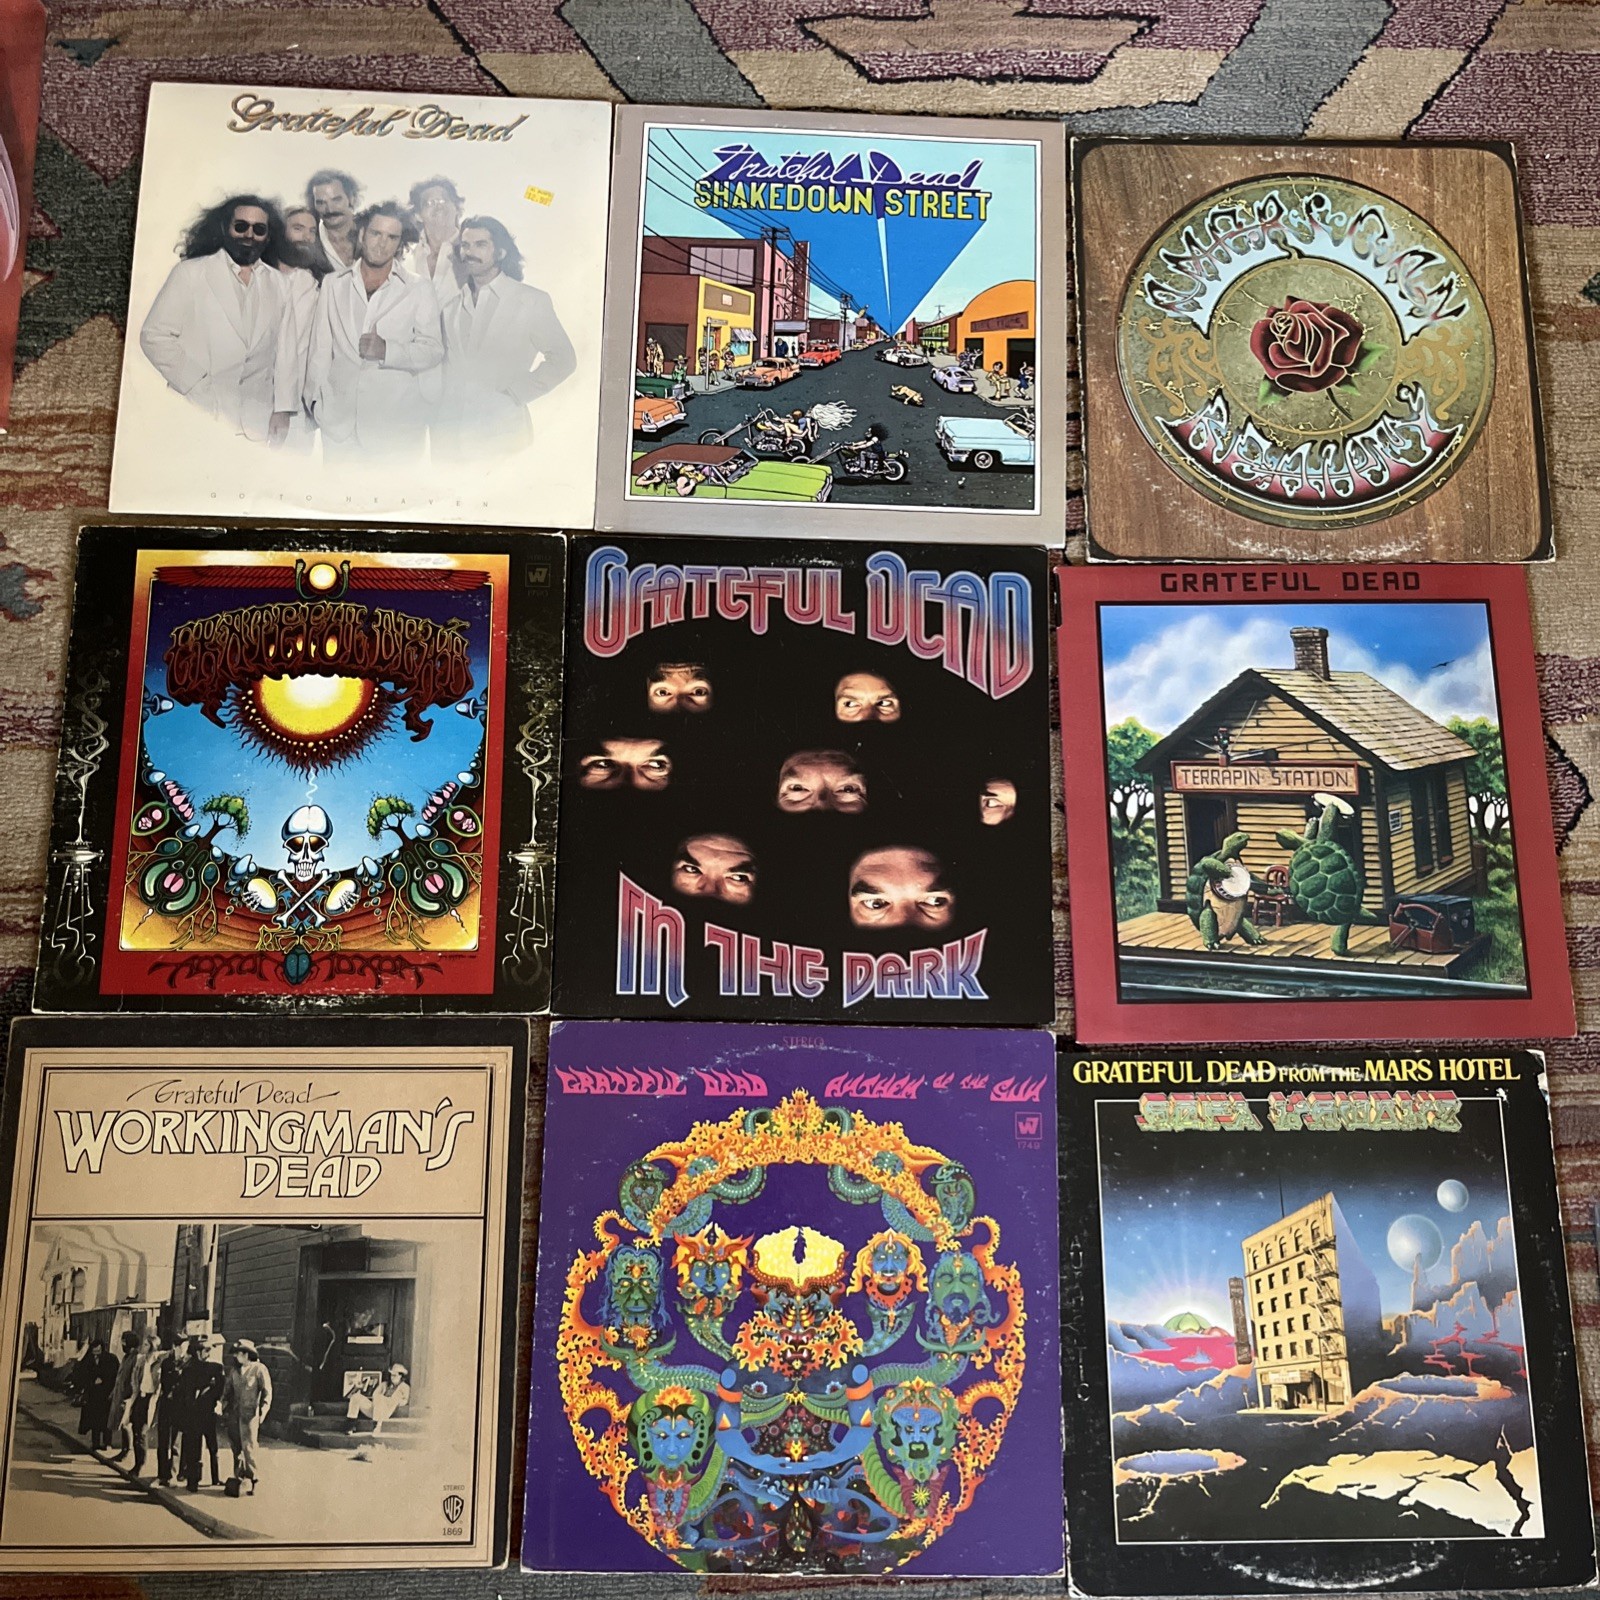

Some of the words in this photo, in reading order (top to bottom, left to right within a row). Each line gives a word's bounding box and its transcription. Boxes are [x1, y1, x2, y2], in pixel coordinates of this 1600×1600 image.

[226, 93, 405, 138] Grateful
[402, 104, 529, 142] Dead
[705, 143, 857, 185] Grateful
[851, 149, 984, 190] Dead
[694, 181, 873, 215] SHAKEDOWN
[885, 189, 992, 221] STREET
[210, 492, 245, 500] GO
[279, 494, 312, 502] TO
[346, 496, 488, 508] HEAVEN
[1160, 571, 1321, 593] GRATEFUL
[1342, 571, 1421, 592] DEAD
[583, 545, 856, 658] GRATEFUL
[865, 550, 1034, 700] DEAD
[1182, 769, 1260, 789] TERRAPIN
[1271, 769, 1349, 789] STATION
[704, 922, 829, 998] THE
[843, 928, 989, 1008] DARK
[783, 1036, 825, 1048] STEREO
[555, 1065, 687, 1096] GRATEFUL
[694, 1067, 768, 1097] DEAD
[824, 1071, 925, 1099] ANTHEM
[932, 1072, 955, 1089] OF
[960, 1073, 990, 1089] THE
[990, 1074, 1048, 1102] SUN
[1072, 1060, 1201, 1084] GRATEFUL
[1206, 1060, 1276, 1083] DEAD
[1279, 1067, 1325, 1082] FROM
[1330, 1067, 1361, 1082] THE
[1364, 1058, 1433, 1082] MARS
[1439, 1058, 1521, 1081] HOTEL
[127, 1079, 243, 1105] Grateful
[240, 1082, 340, 1105] Dead
[53, 1097, 475, 1174] WORKINGMAN'S
[240, 1155, 382, 1198] DEAD
[443, 1527, 463, 1536] 1869
